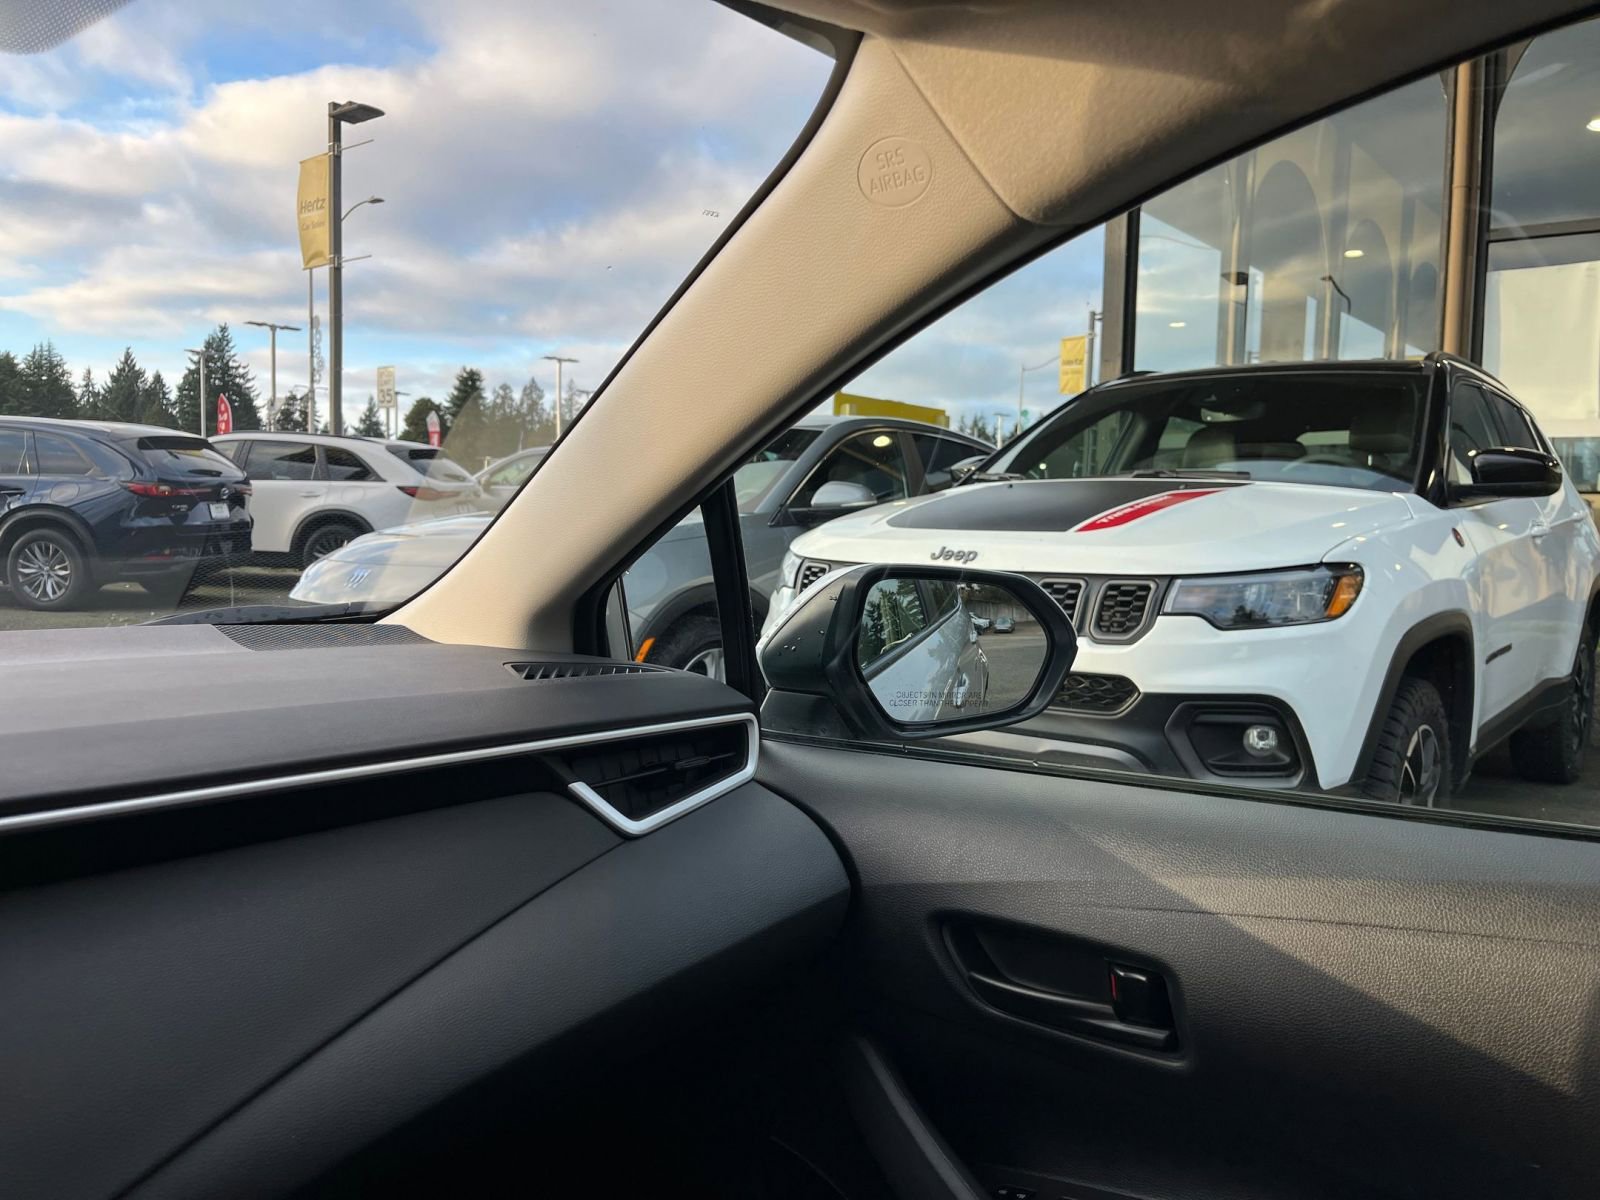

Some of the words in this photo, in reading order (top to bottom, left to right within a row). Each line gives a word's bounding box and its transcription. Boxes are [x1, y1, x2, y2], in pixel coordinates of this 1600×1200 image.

[876, 146, 905, 171] SRS
[869, 165, 925, 196] AIRBAG
[300, 196, 326, 214] Hertz
[379, 388, 393, 404] 35
[930, 546, 978, 564] Jeep
[889, 699, 918, 707] CLOSER
[919, 699, 939, 707] THAN
[896, 691, 928, 699] OBJECTS
[929, 691, 937, 699] IN
[968, 691, 982, 699] ARE
